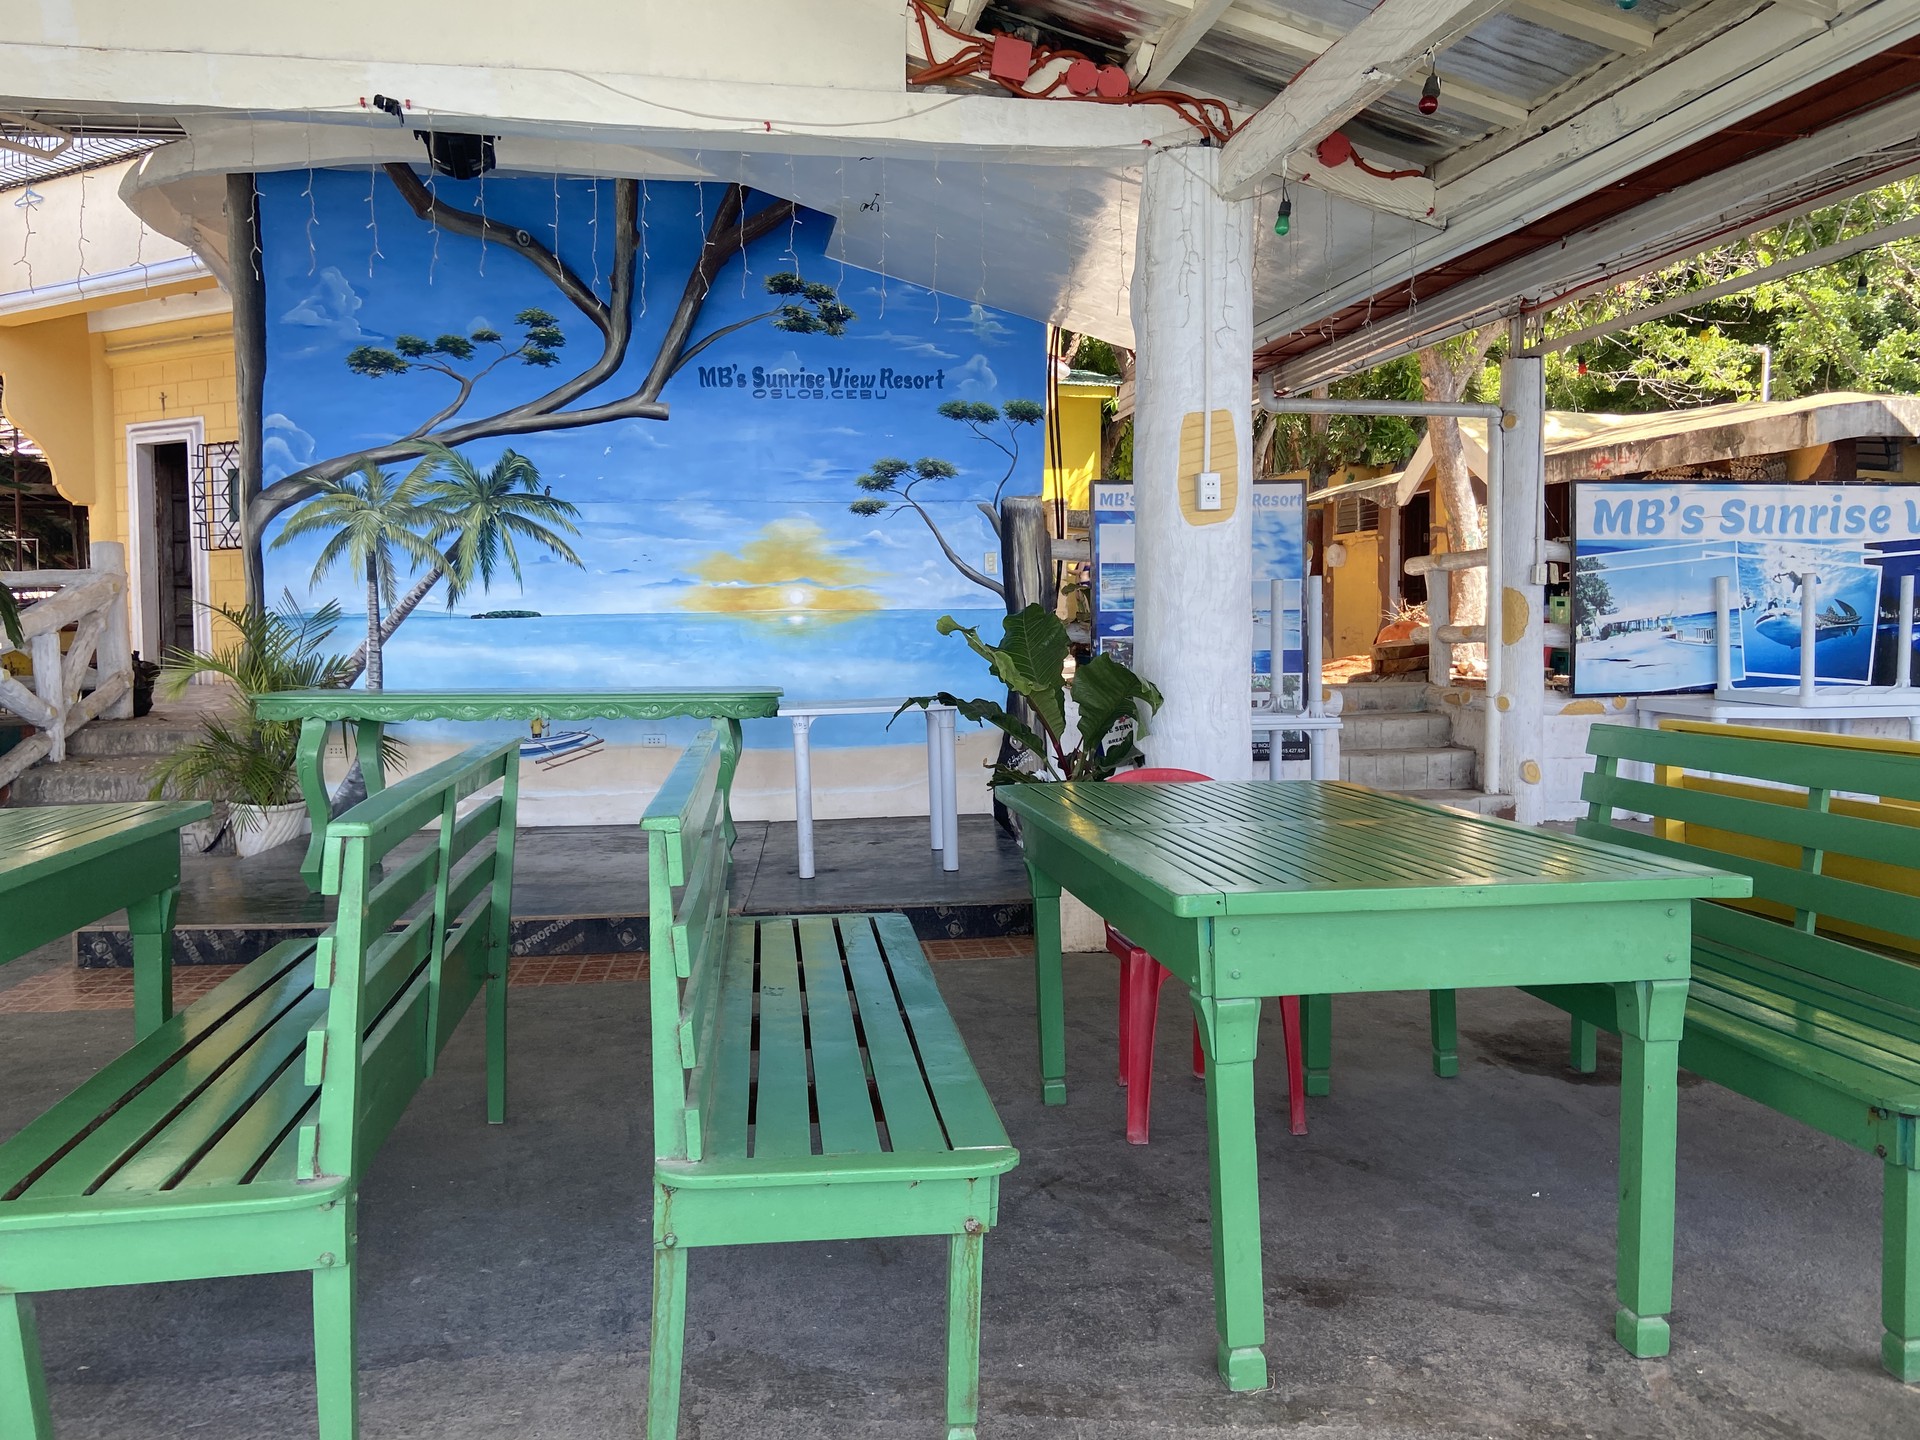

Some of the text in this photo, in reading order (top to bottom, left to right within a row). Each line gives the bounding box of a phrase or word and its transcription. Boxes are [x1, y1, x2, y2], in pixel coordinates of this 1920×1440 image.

[698, 364, 945, 389] MB's Sunrise View Resort
[1593, 496, 1705, 535] MB's
[1719, 495, 1891, 535] Sunrise
